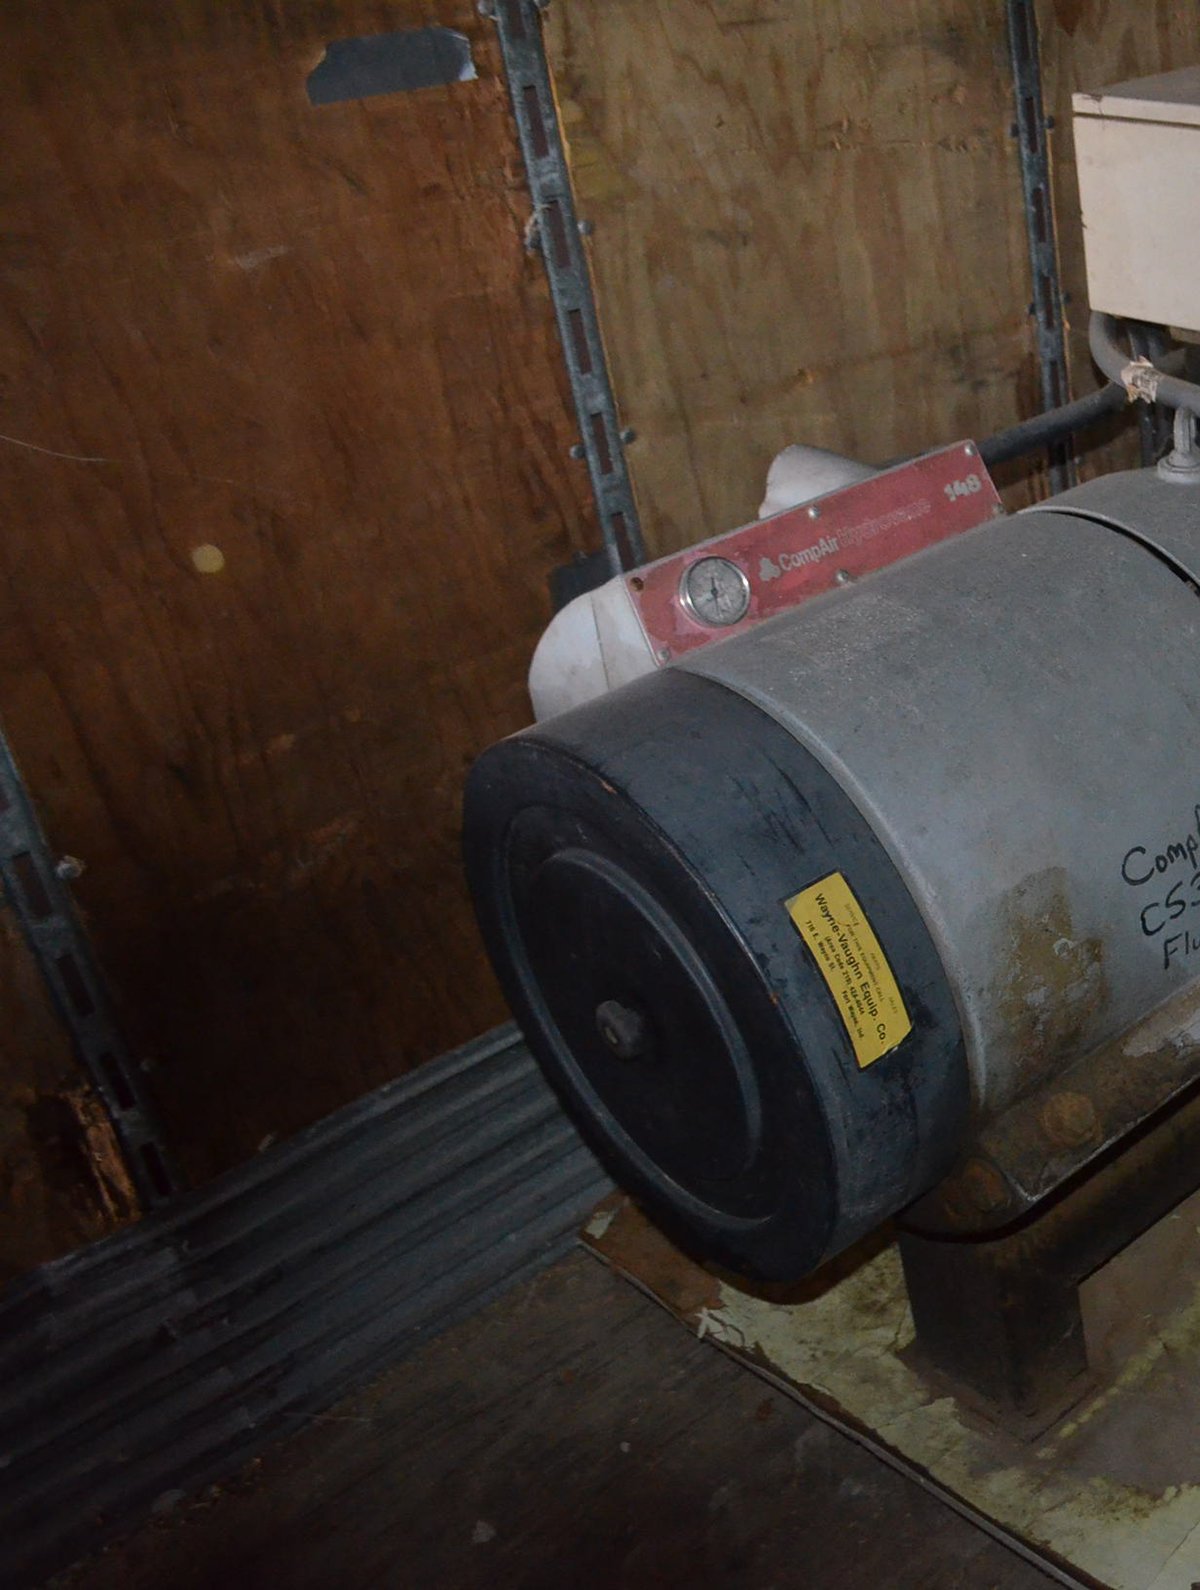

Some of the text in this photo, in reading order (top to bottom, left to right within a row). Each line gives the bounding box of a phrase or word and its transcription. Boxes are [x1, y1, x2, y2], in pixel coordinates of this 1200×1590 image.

[778, 528, 842, 573] CompAir
[943, 473, 982, 502] 148
[815, 893, 886, 1045] Wayne-Vaughn Equip. Co.
